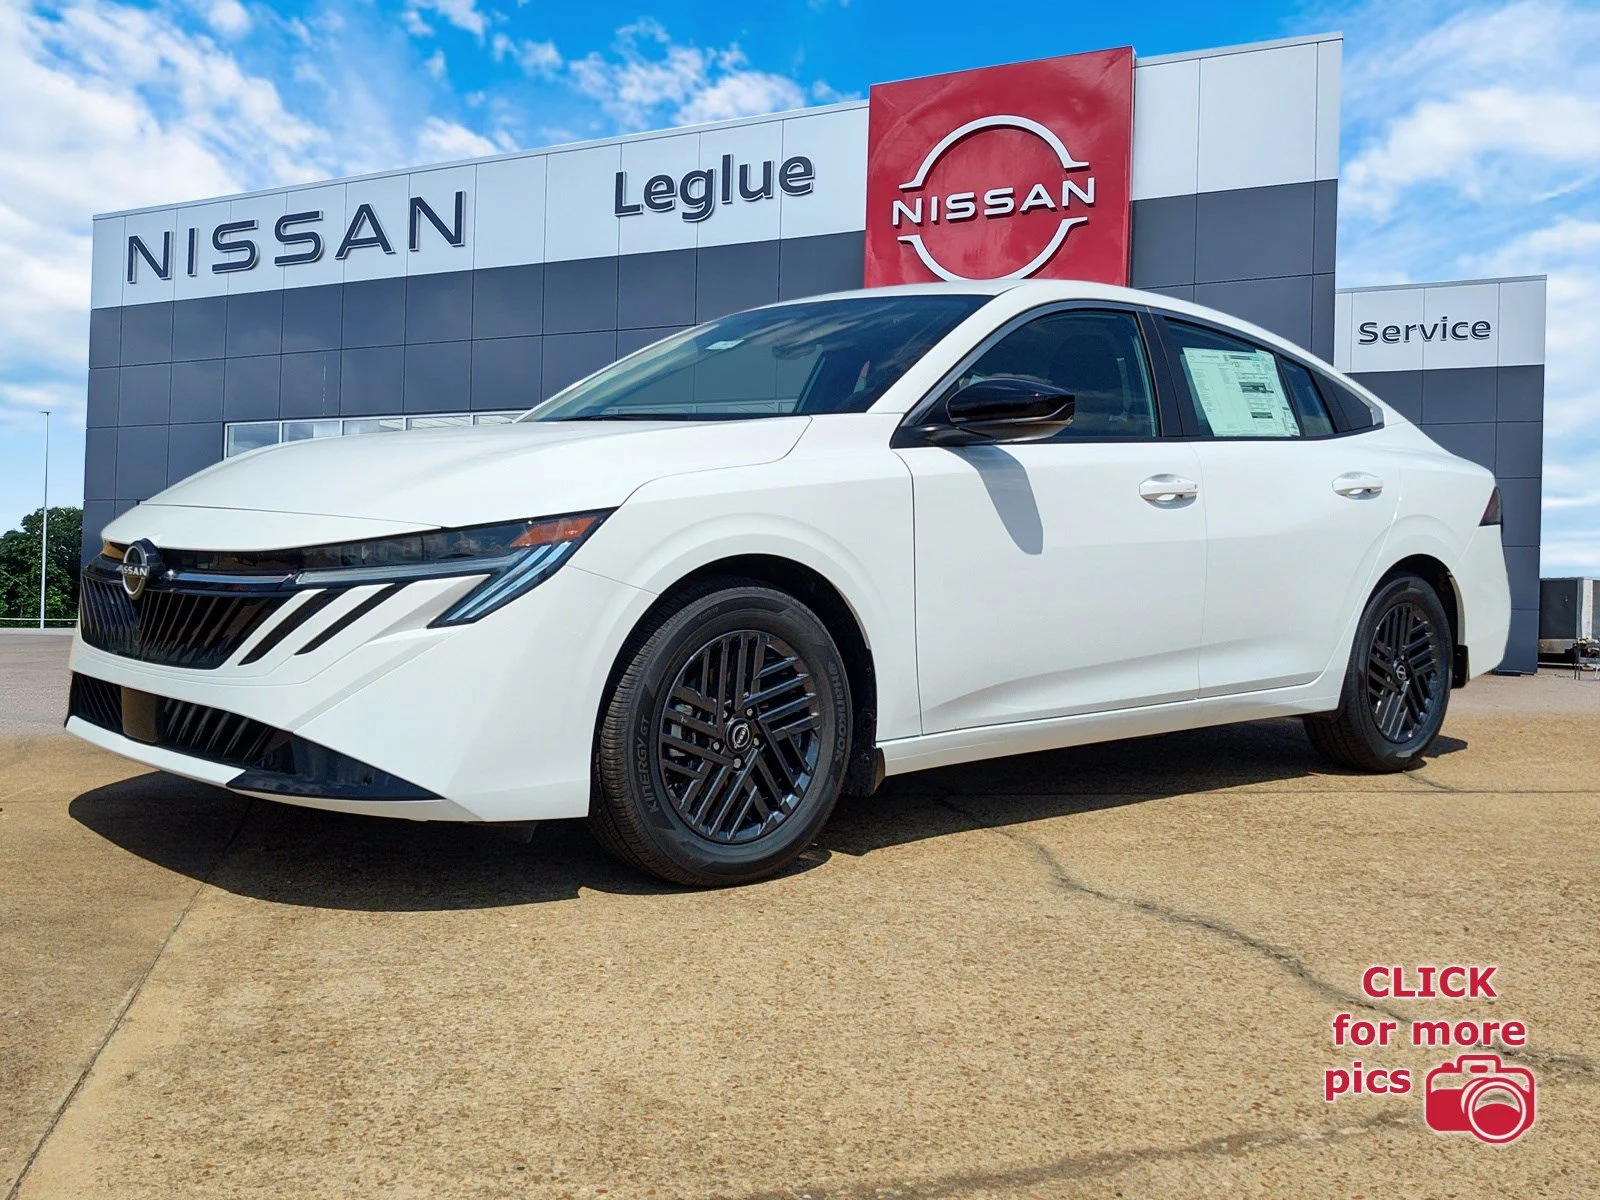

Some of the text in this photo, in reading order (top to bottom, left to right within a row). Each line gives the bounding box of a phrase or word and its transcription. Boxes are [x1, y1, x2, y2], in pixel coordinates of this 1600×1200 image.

[614, 153, 815, 222] Leglue
[892, 177, 1095, 226] NISSAN
[127, 191, 466, 284] NISSAN
[1358, 315, 1492, 344] Service
[122, 565, 148, 577] SSAN
